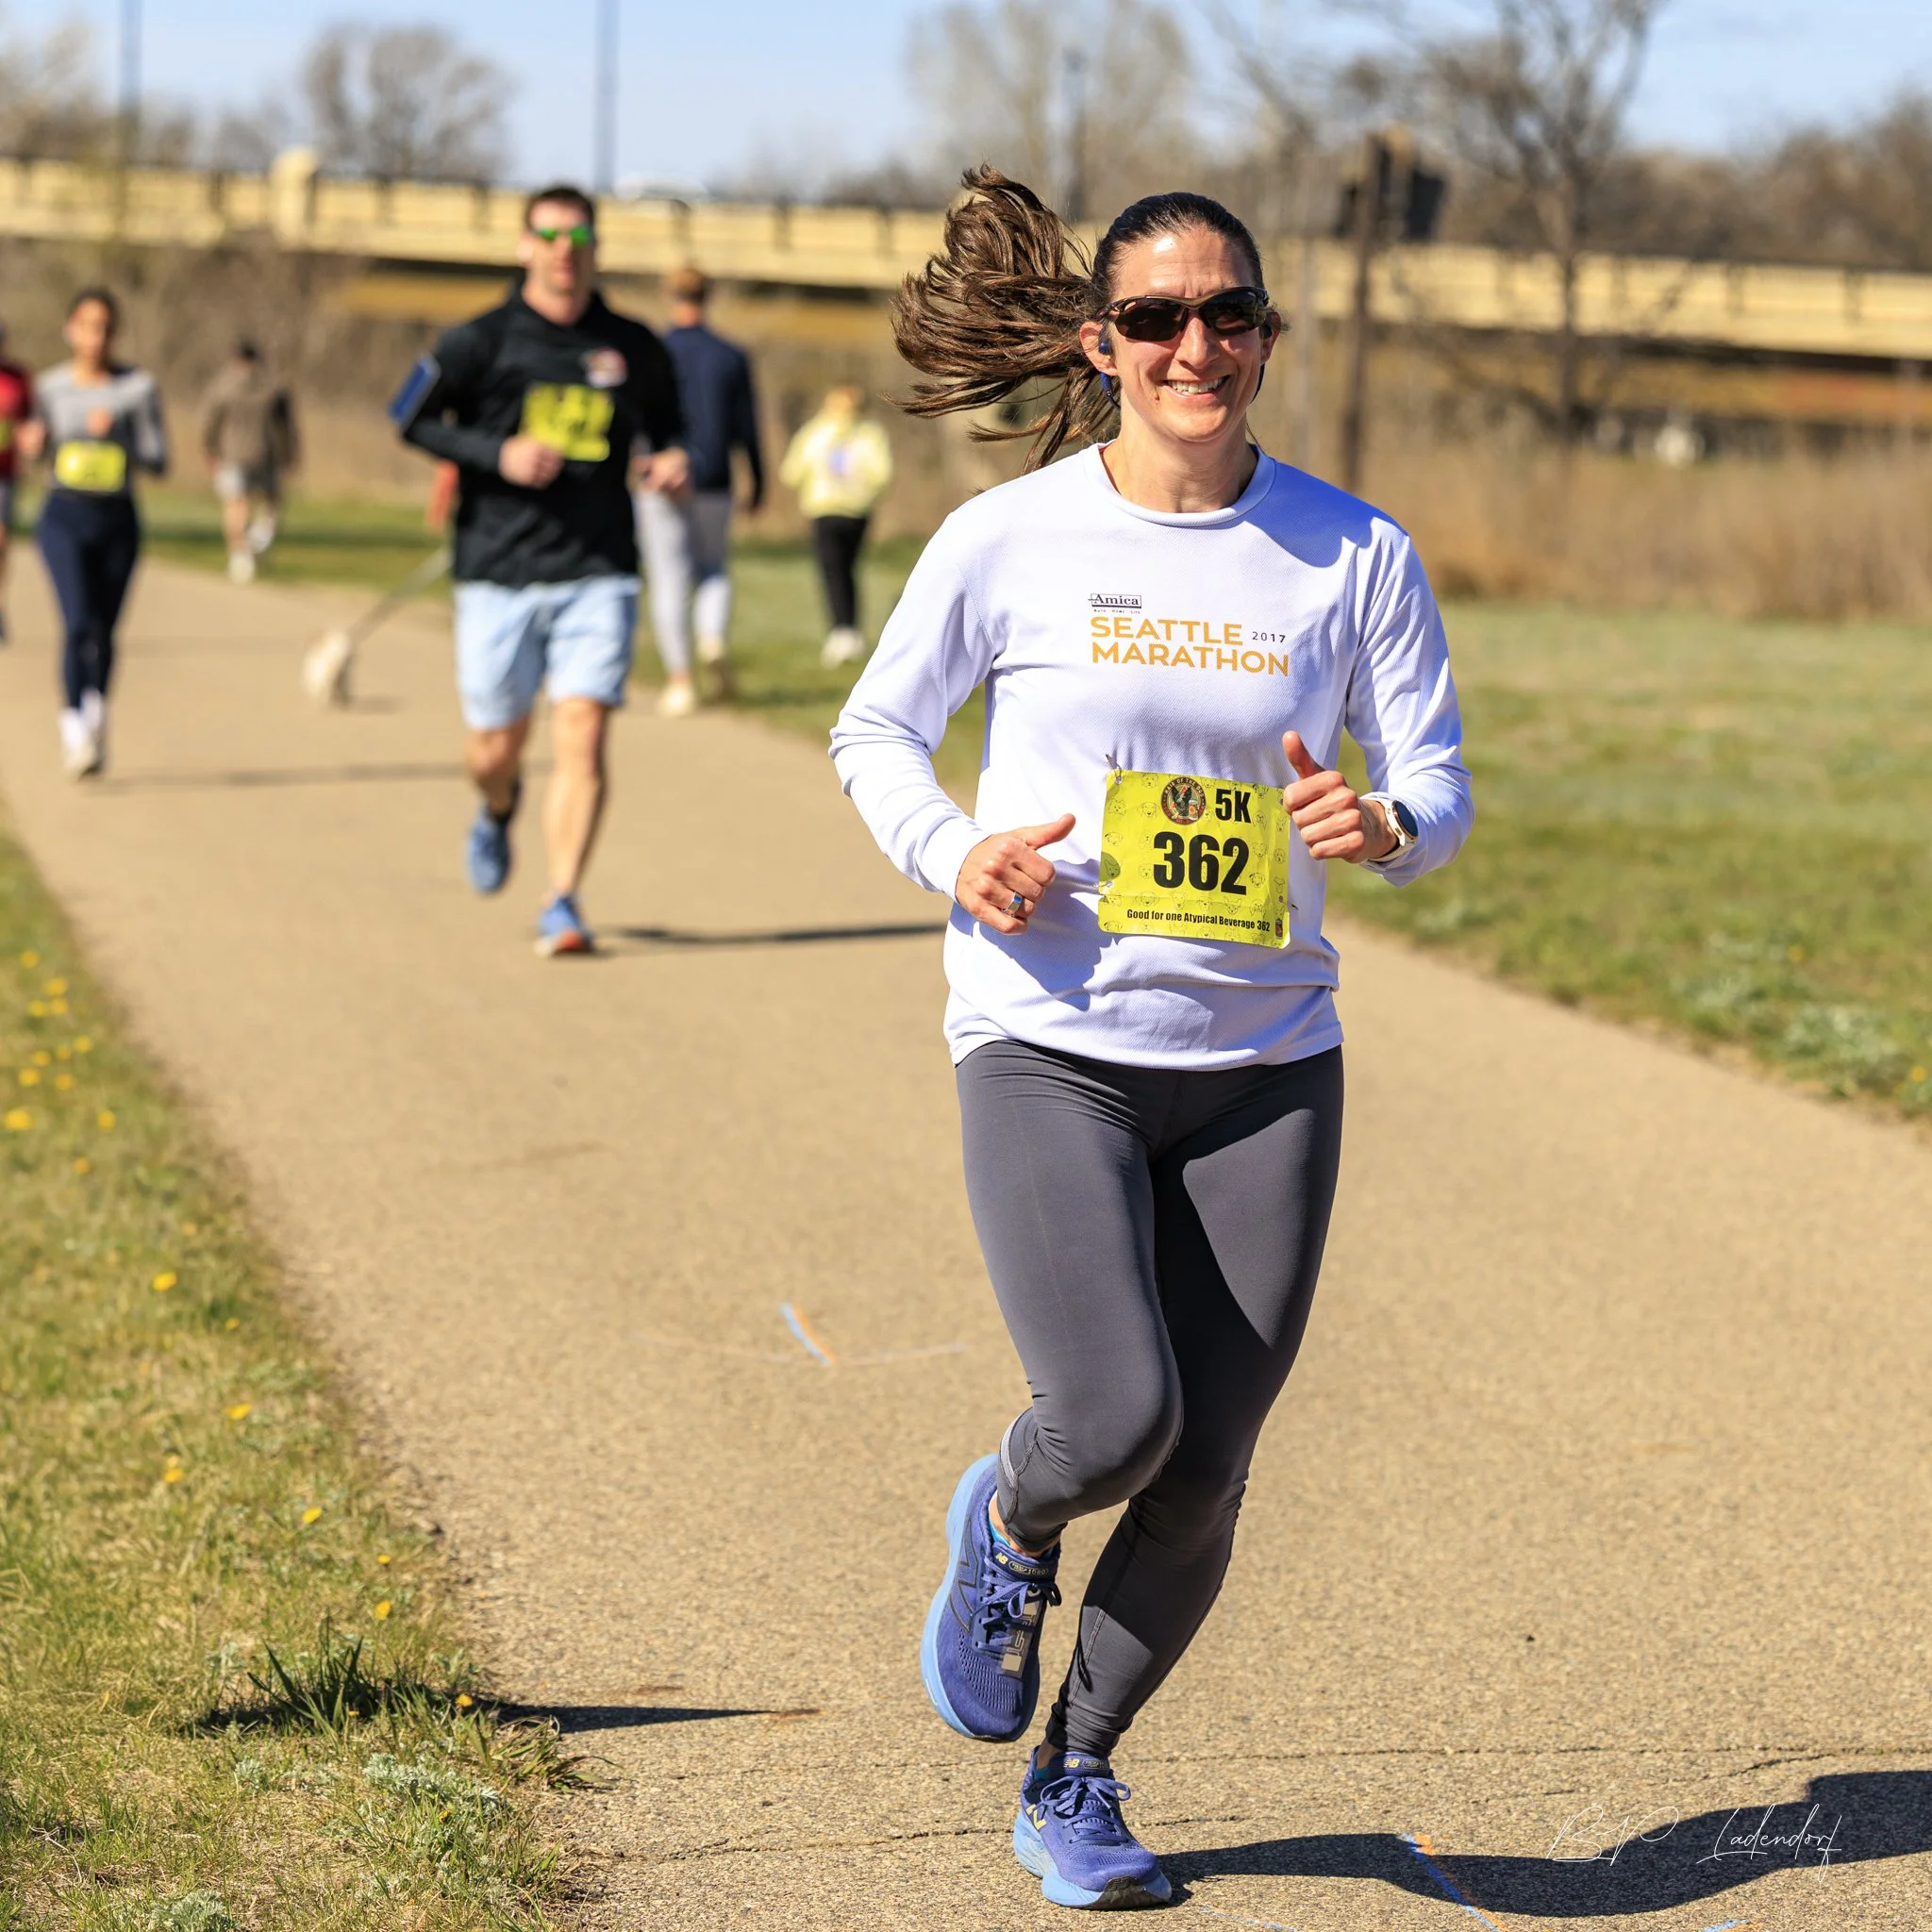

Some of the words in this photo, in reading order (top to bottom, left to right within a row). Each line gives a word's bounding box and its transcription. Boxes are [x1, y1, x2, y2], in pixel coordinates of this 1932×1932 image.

[1088, 593, 1140, 606] Amica
[1091, 616, 1243, 646] SEATTLE
[1252, 631, 1286, 643] 2017
[1091, 641, 1289, 677] MARATHON
[1186, 778, 1196, 787] THE
[1215, 788, 1252, 824] 5K
[1153, 831, 1250, 895] 362
[1126, 908, 1150, 920] Good
[1151, 911, 1163, 921] for
[1165, 913, 1182, 922] one
[1184, 912, 1218, 925] Atypical
[1219, 916, 1256, 929] Beverage
[1257, 920, 1271, 932] 362
